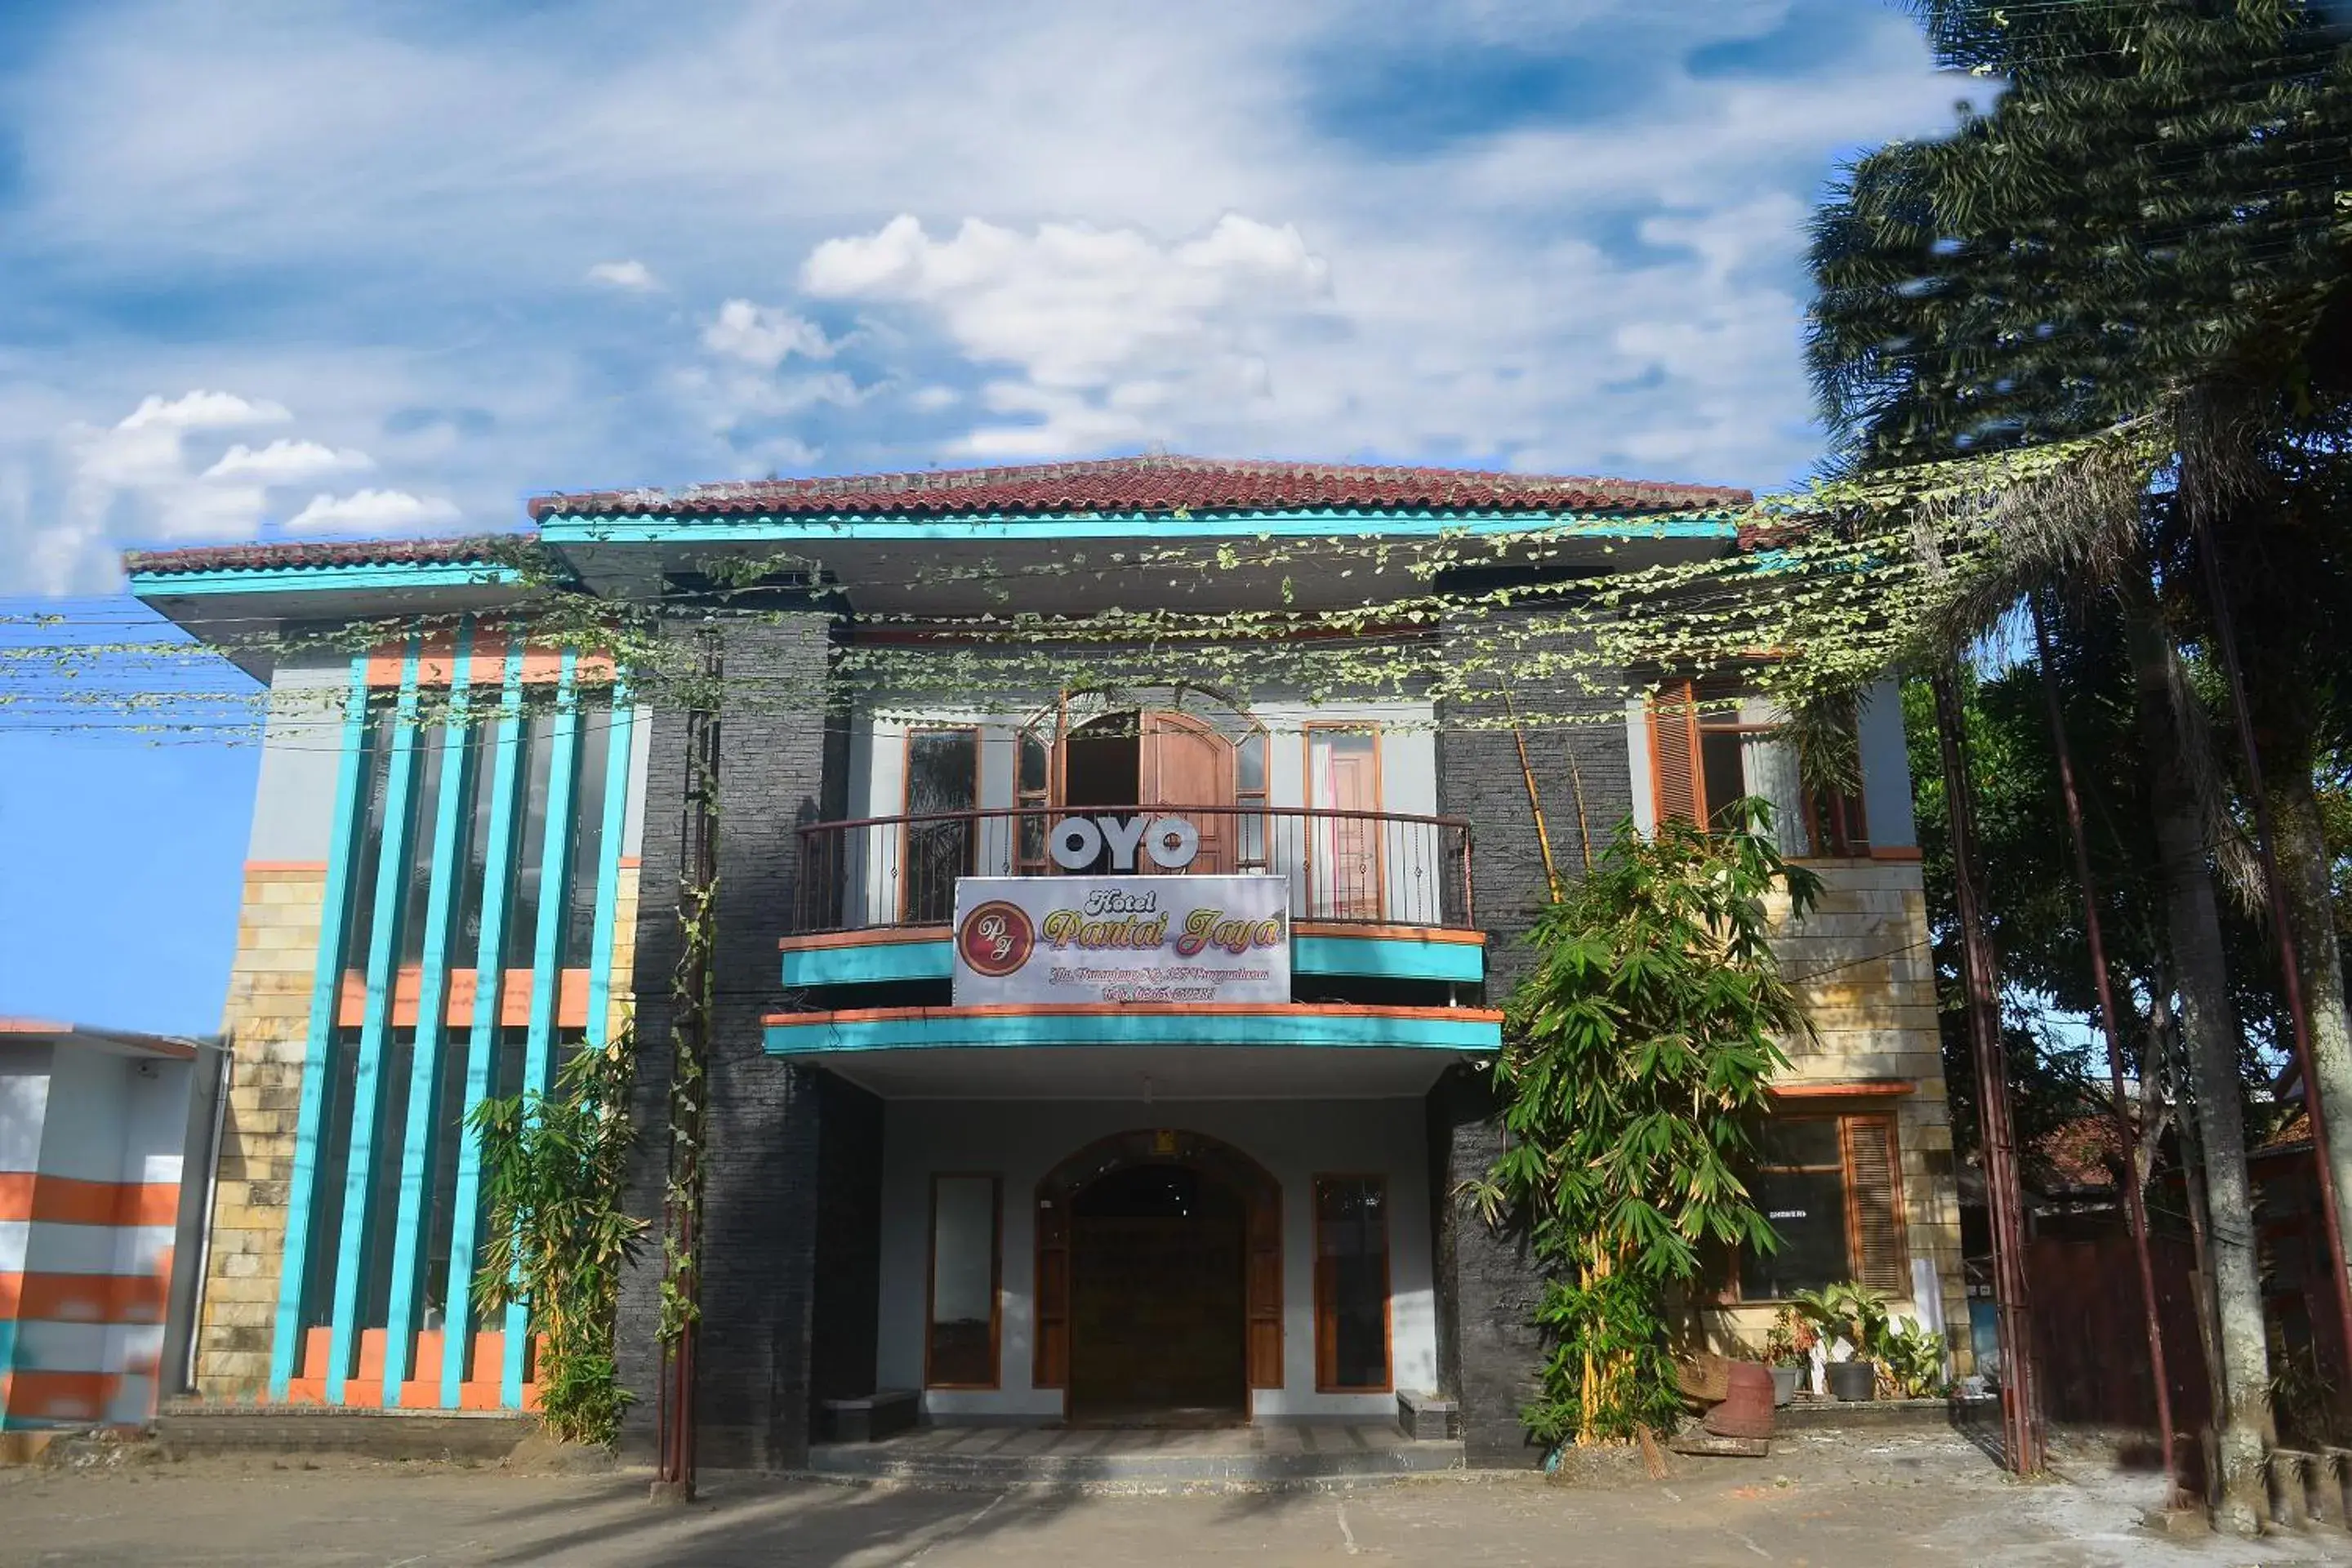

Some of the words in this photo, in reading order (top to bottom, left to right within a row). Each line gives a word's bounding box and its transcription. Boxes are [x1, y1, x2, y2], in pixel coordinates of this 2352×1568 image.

[1049, 817, 1199, 870] OYO
[1084, 889, 1156, 916] Hotel
[1042, 909, 1169, 950] Pantai
[1176, 908, 1281, 956] Jaya
